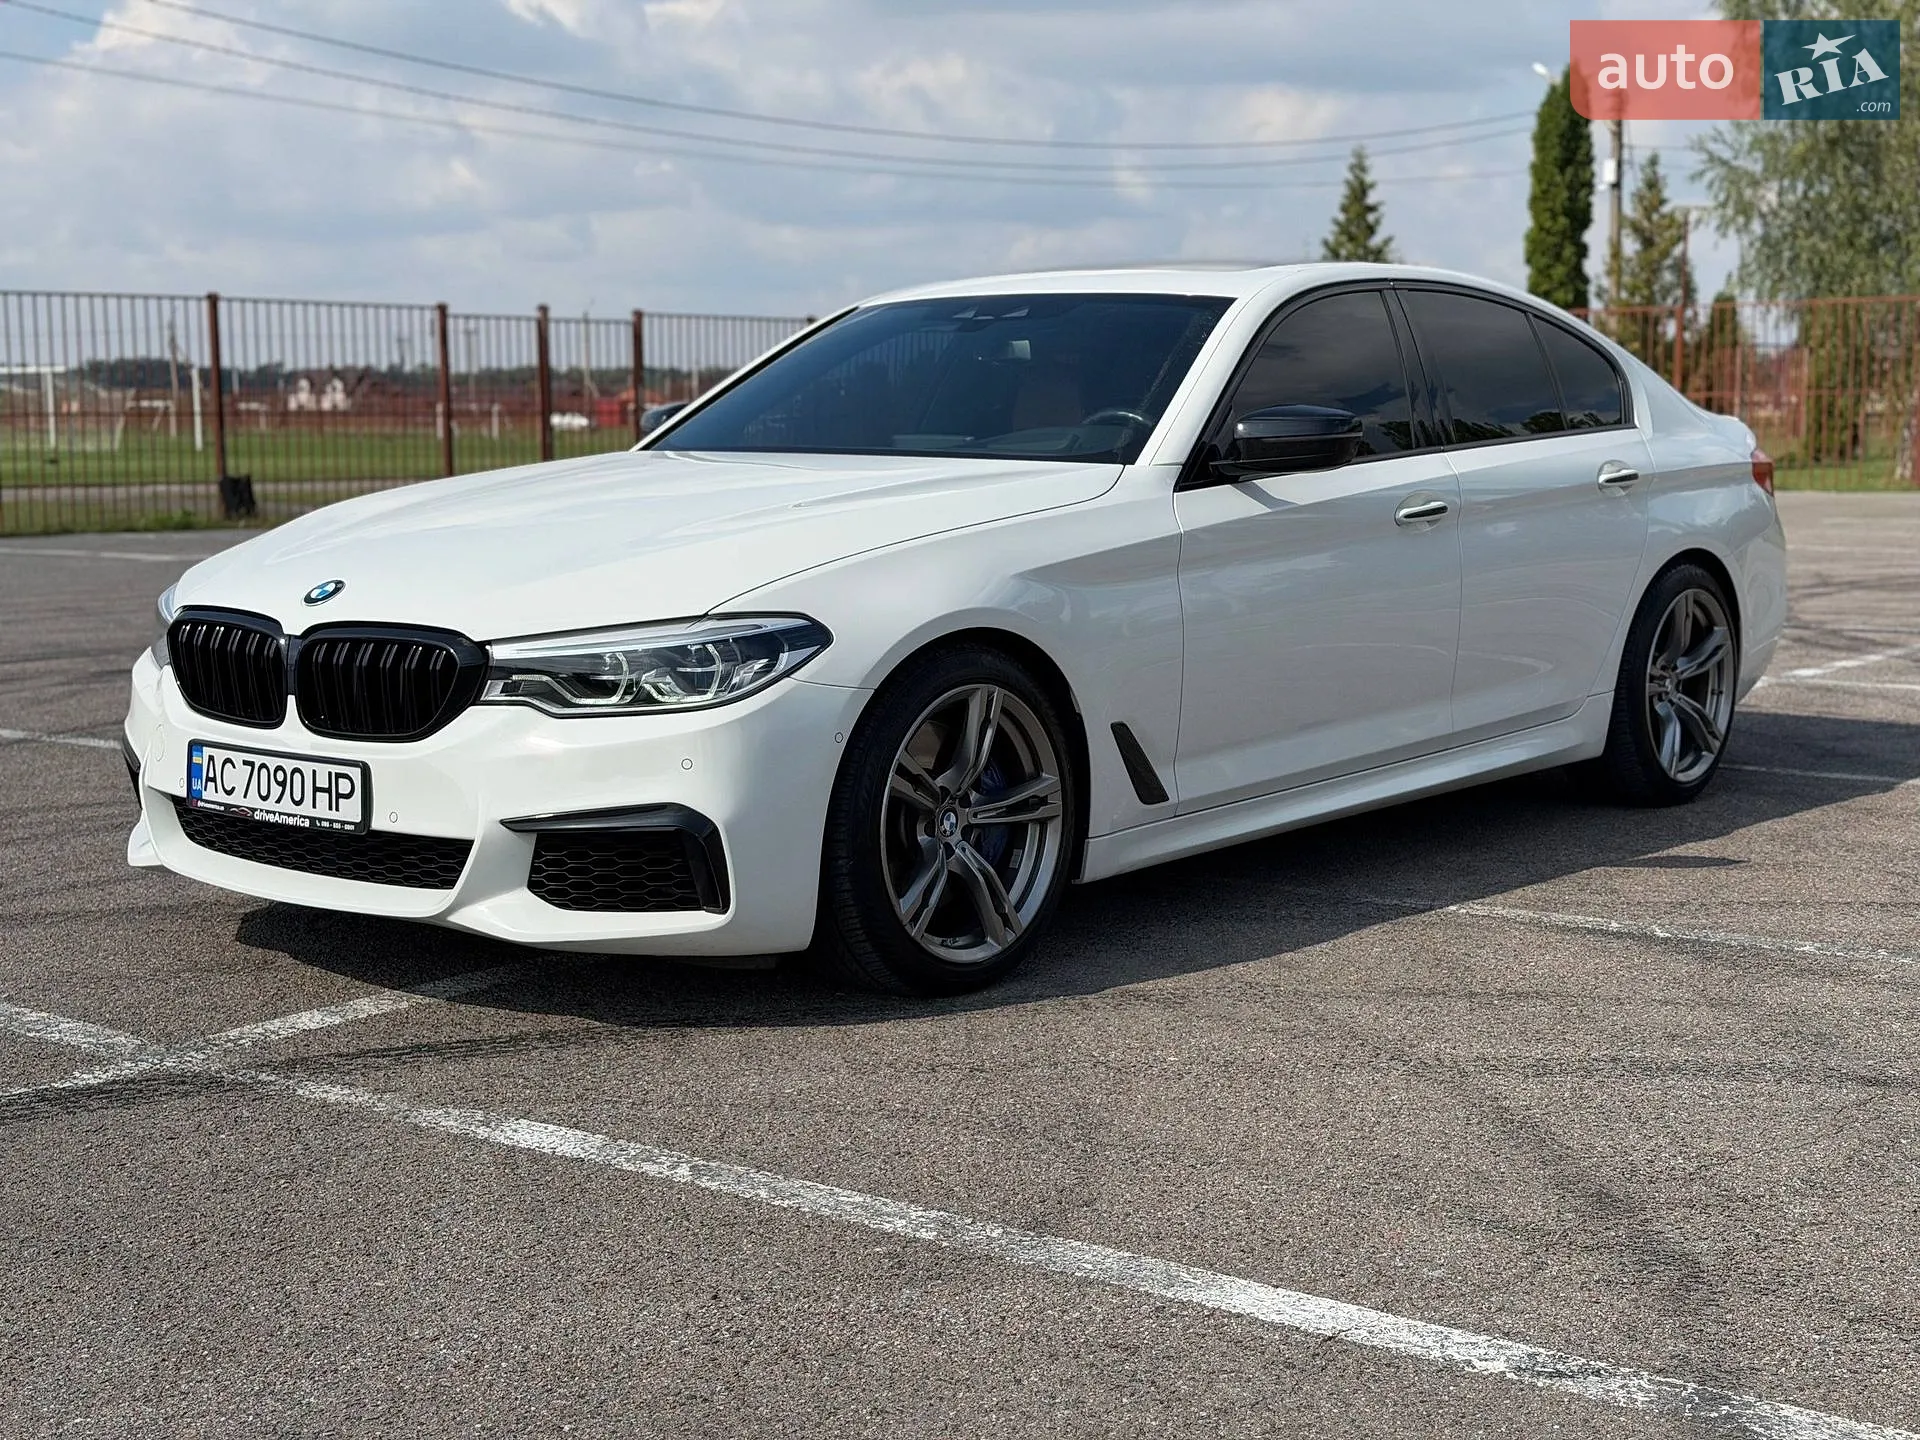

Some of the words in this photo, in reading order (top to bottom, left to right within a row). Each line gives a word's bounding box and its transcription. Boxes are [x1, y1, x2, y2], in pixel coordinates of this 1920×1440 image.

[192, 778, 202, 790] UA
[204, 755, 237, 796] AC
[242, 759, 306, 807] 7090
[312, 769, 356, 812] HP
[254, 808, 310, 827] driveAmerica
